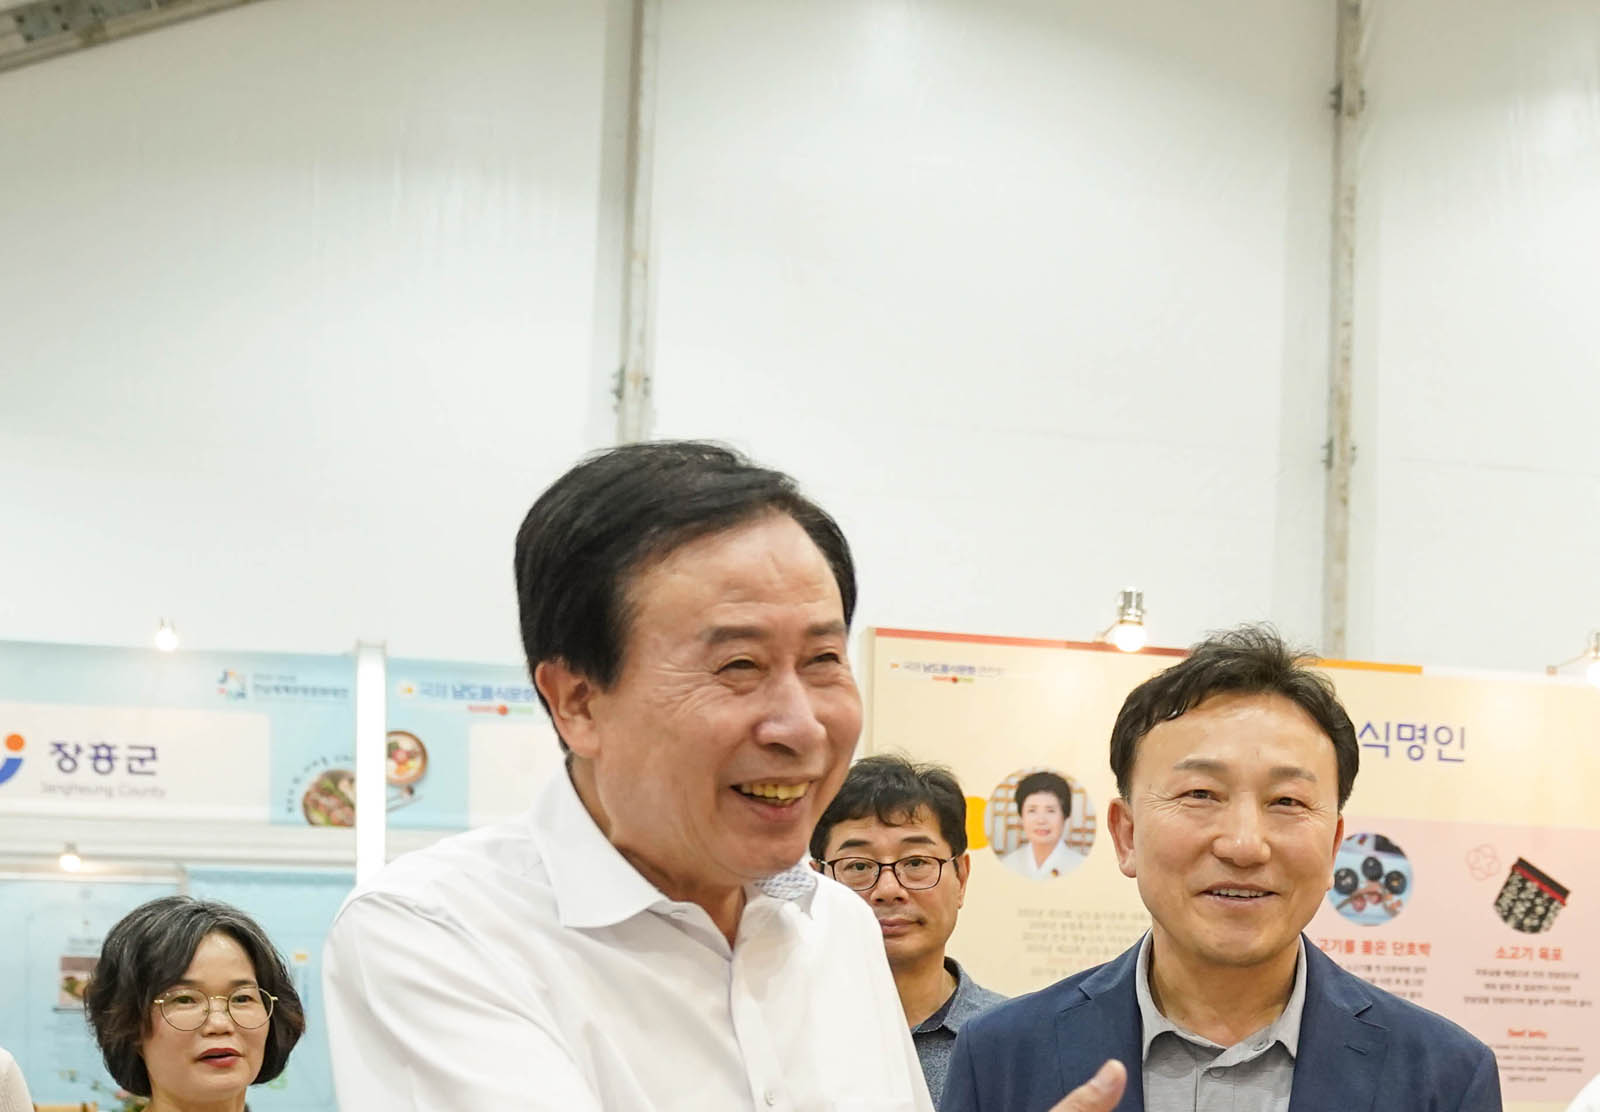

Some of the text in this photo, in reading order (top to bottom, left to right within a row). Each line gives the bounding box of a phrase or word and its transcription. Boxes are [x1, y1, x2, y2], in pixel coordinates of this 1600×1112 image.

[49, 741, 159, 777] 장흥군
[1358, 721, 1466, 762] 식명인
[1495, 946, 1534, 961] 소고기
